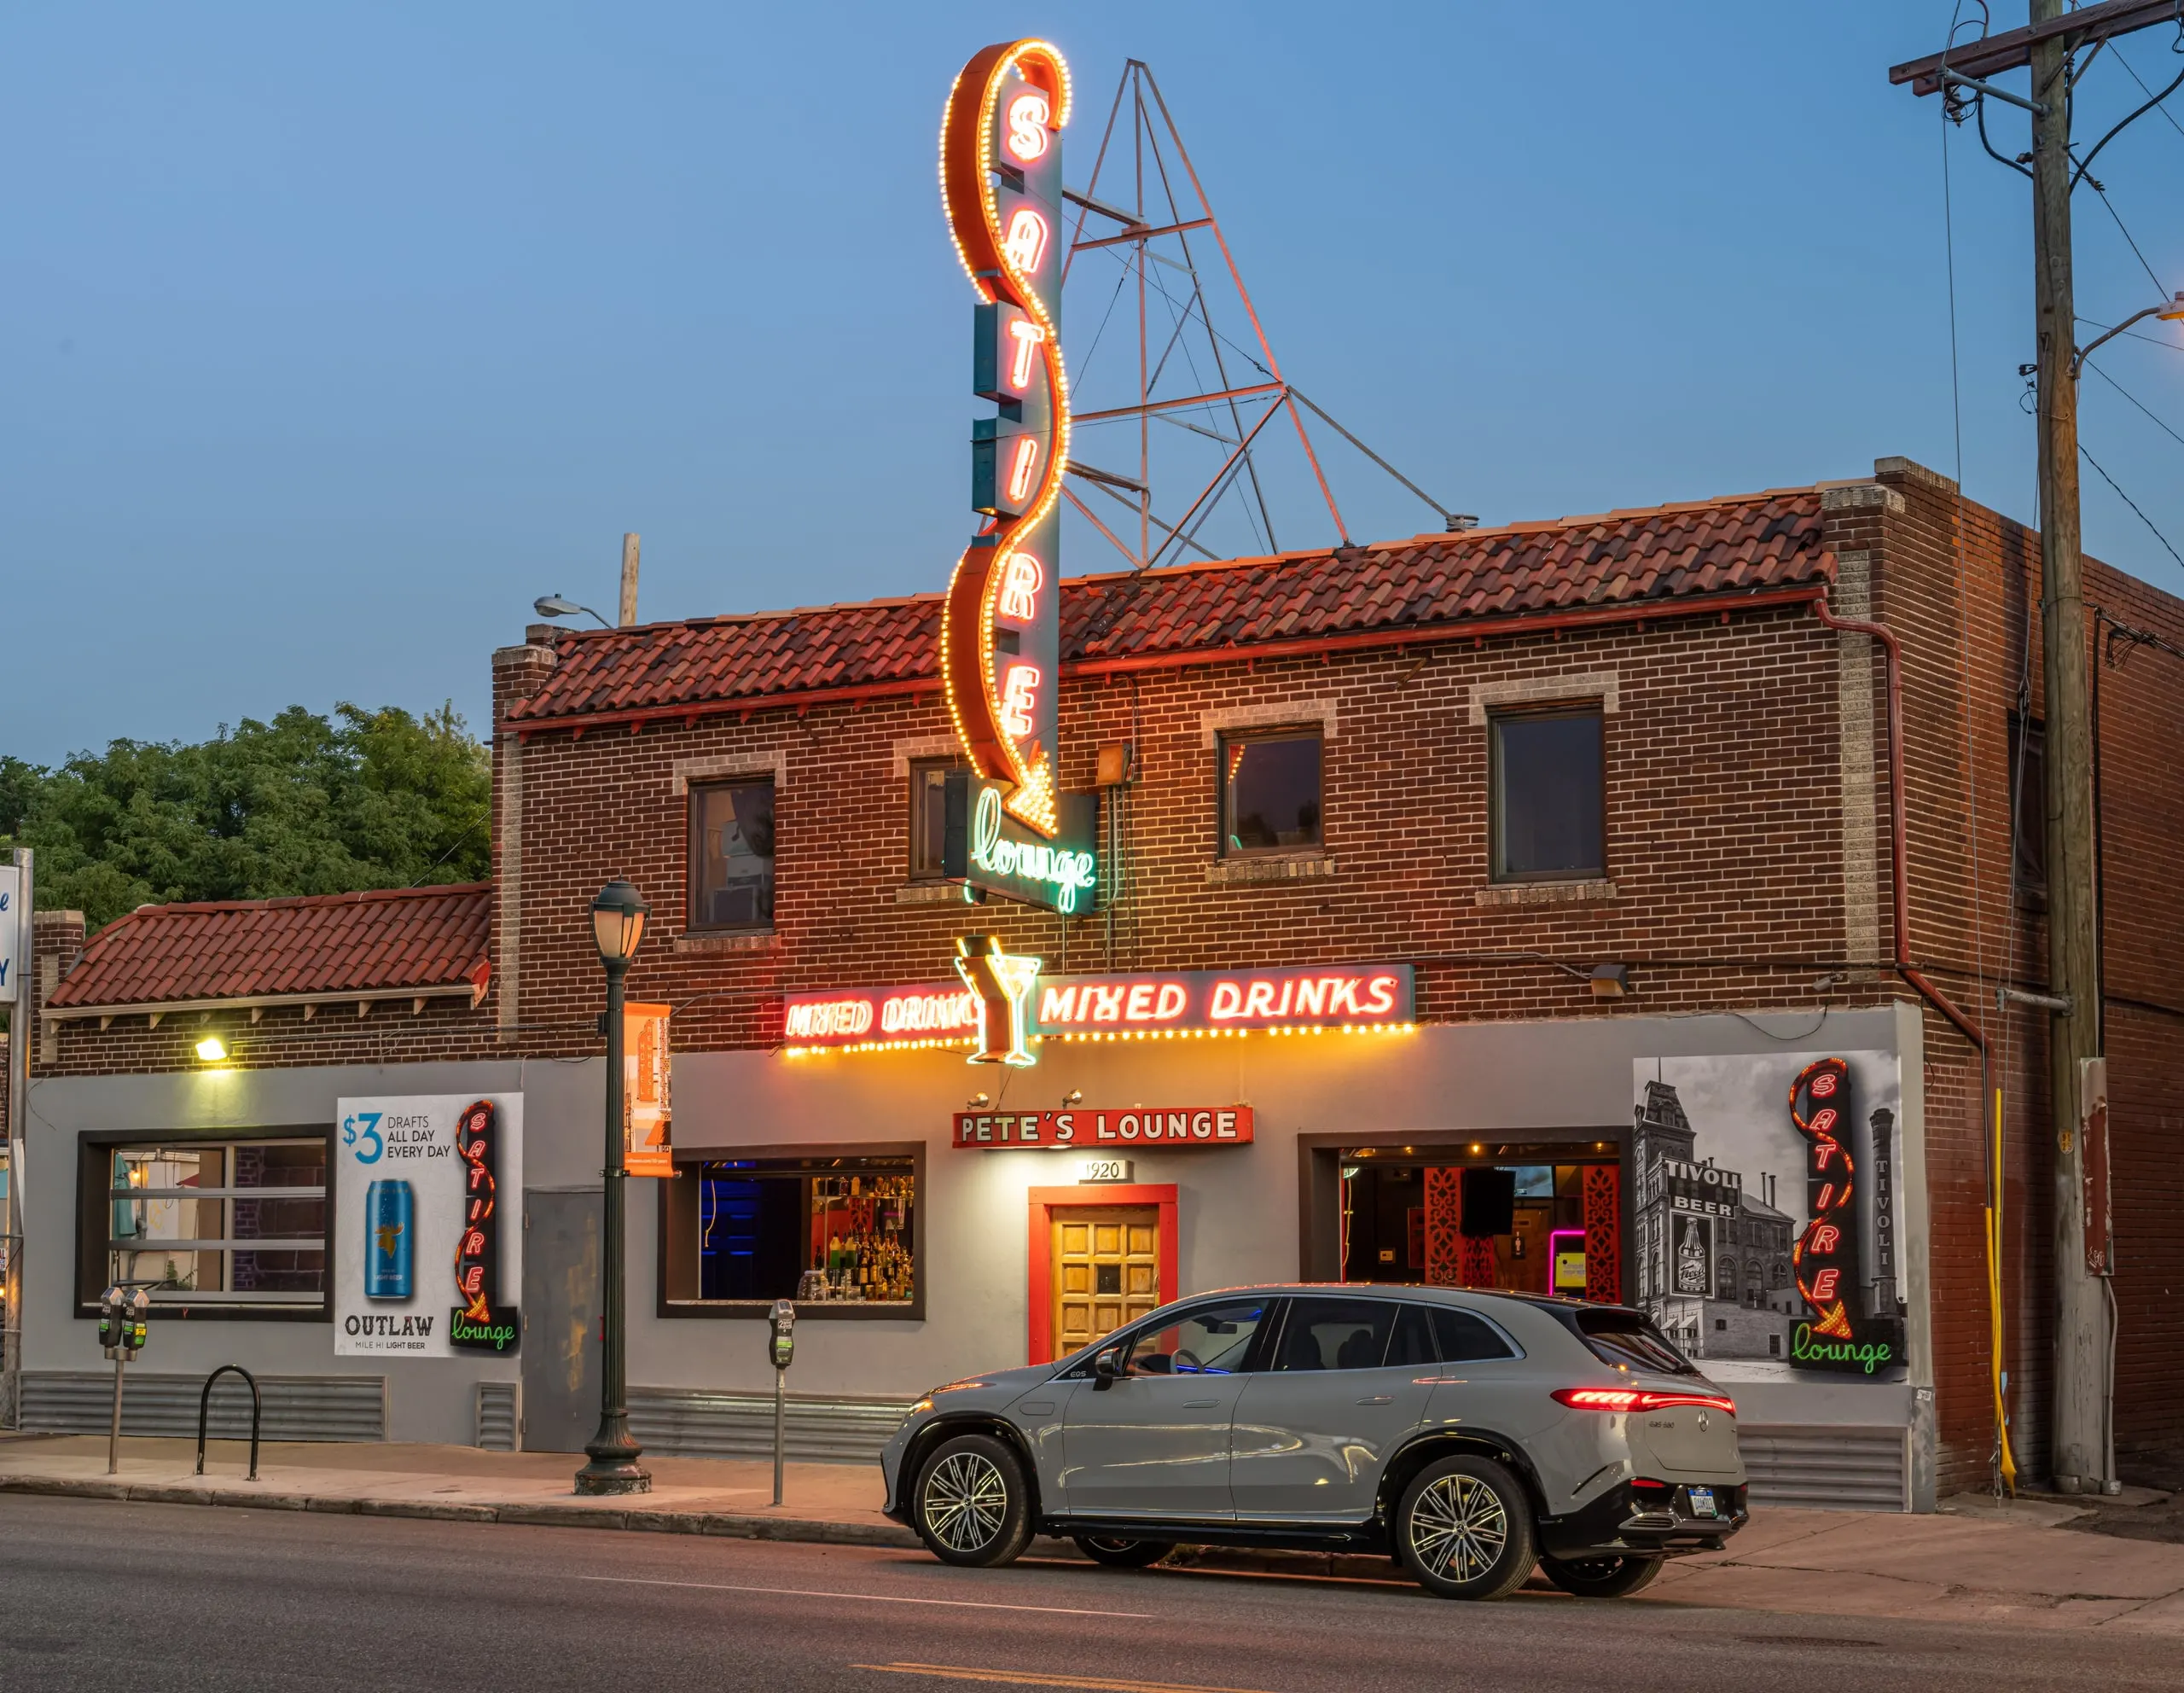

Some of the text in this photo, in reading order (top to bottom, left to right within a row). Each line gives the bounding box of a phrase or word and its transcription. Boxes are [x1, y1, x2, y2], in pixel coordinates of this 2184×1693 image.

[1000, 94, 1048, 736] SATIRE
[971, 786, 1095, 914] lounge
[785, 999, 874, 1038] MIXED
[1038, 976, 1398, 1023] MIXED DRINKS
[343, 1112, 384, 1165] $3
[387, 1115, 429, 1128] DRAFTS
[387, 1130, 435, 1143] ALL DAY
[961, 1111, 1237, 1142] PETE'S LOUNGE
[387, 1144, 451, 1158] EVERY DAY
[1086, 1161, 1120, 1180] 1920
[1664, 1159, 1738, 1189] TIVOLI
[1809, 1072, 1840, 1300] SATIRE
[465, 1112, 486, 1294] SATIRE
[1675, 1196, 1731, 1217] BEER
[1874, 1159, 1891, 1266] TIVOLI
[345, 1315, 433, 1336] OUTLAW
[452, 1309, 514, 1350] lounge
[1792, 1323, 1891, 1374] lounge
